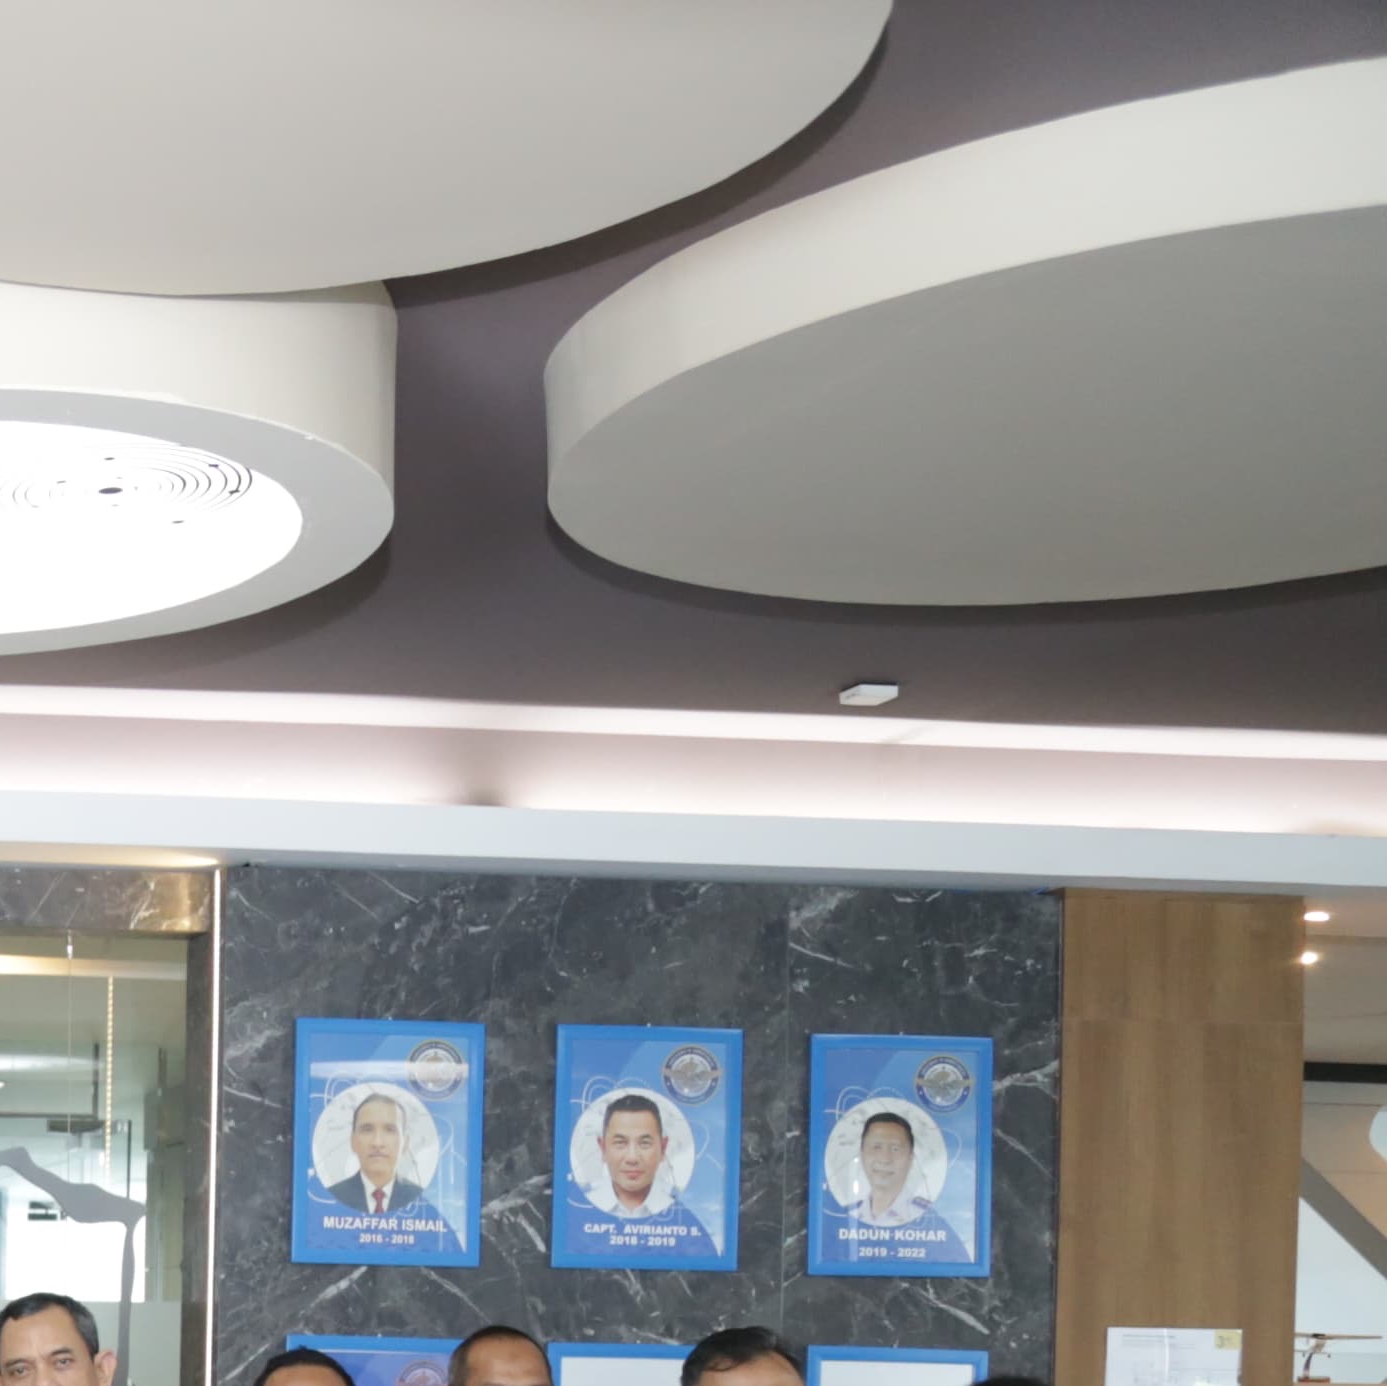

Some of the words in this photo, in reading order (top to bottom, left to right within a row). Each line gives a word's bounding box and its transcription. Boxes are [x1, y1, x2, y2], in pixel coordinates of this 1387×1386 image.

[323, 1216, 398, 1231] MUZAFFAR
[402, 1219, 447, 1232] ISMAIL
[584, 1223, 617, 1234] CAPT.
[623, 1225, 688, 1236] AVIRIANTO
[838, 1228, 891, 1241] DADUN
[894, 1229, 947, 1242] KOHAR
